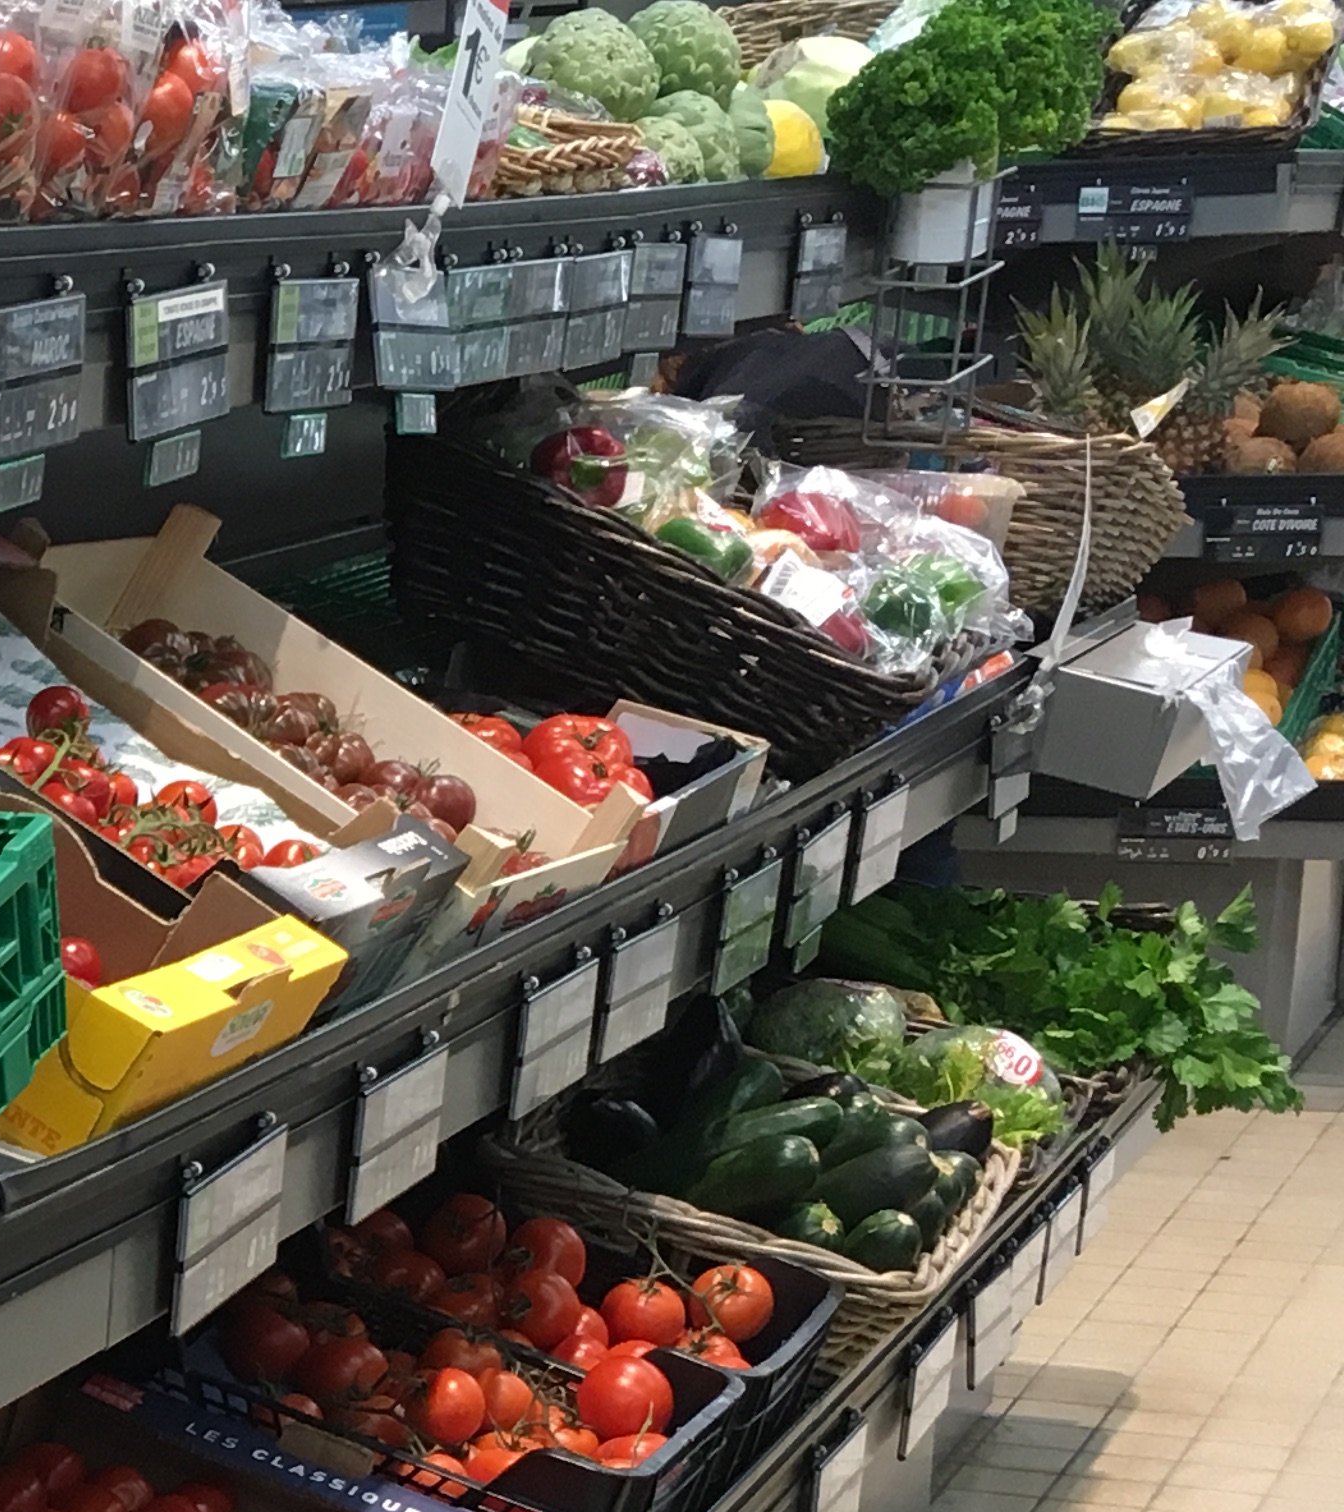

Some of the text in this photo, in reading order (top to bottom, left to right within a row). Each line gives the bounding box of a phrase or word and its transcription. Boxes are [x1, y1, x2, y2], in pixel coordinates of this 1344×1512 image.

[1130, 199, 1182, 212] ESPAGNE
[176, 314, 216, 350] ESPAGNE
[185, 1421, 239, 1450] LES
